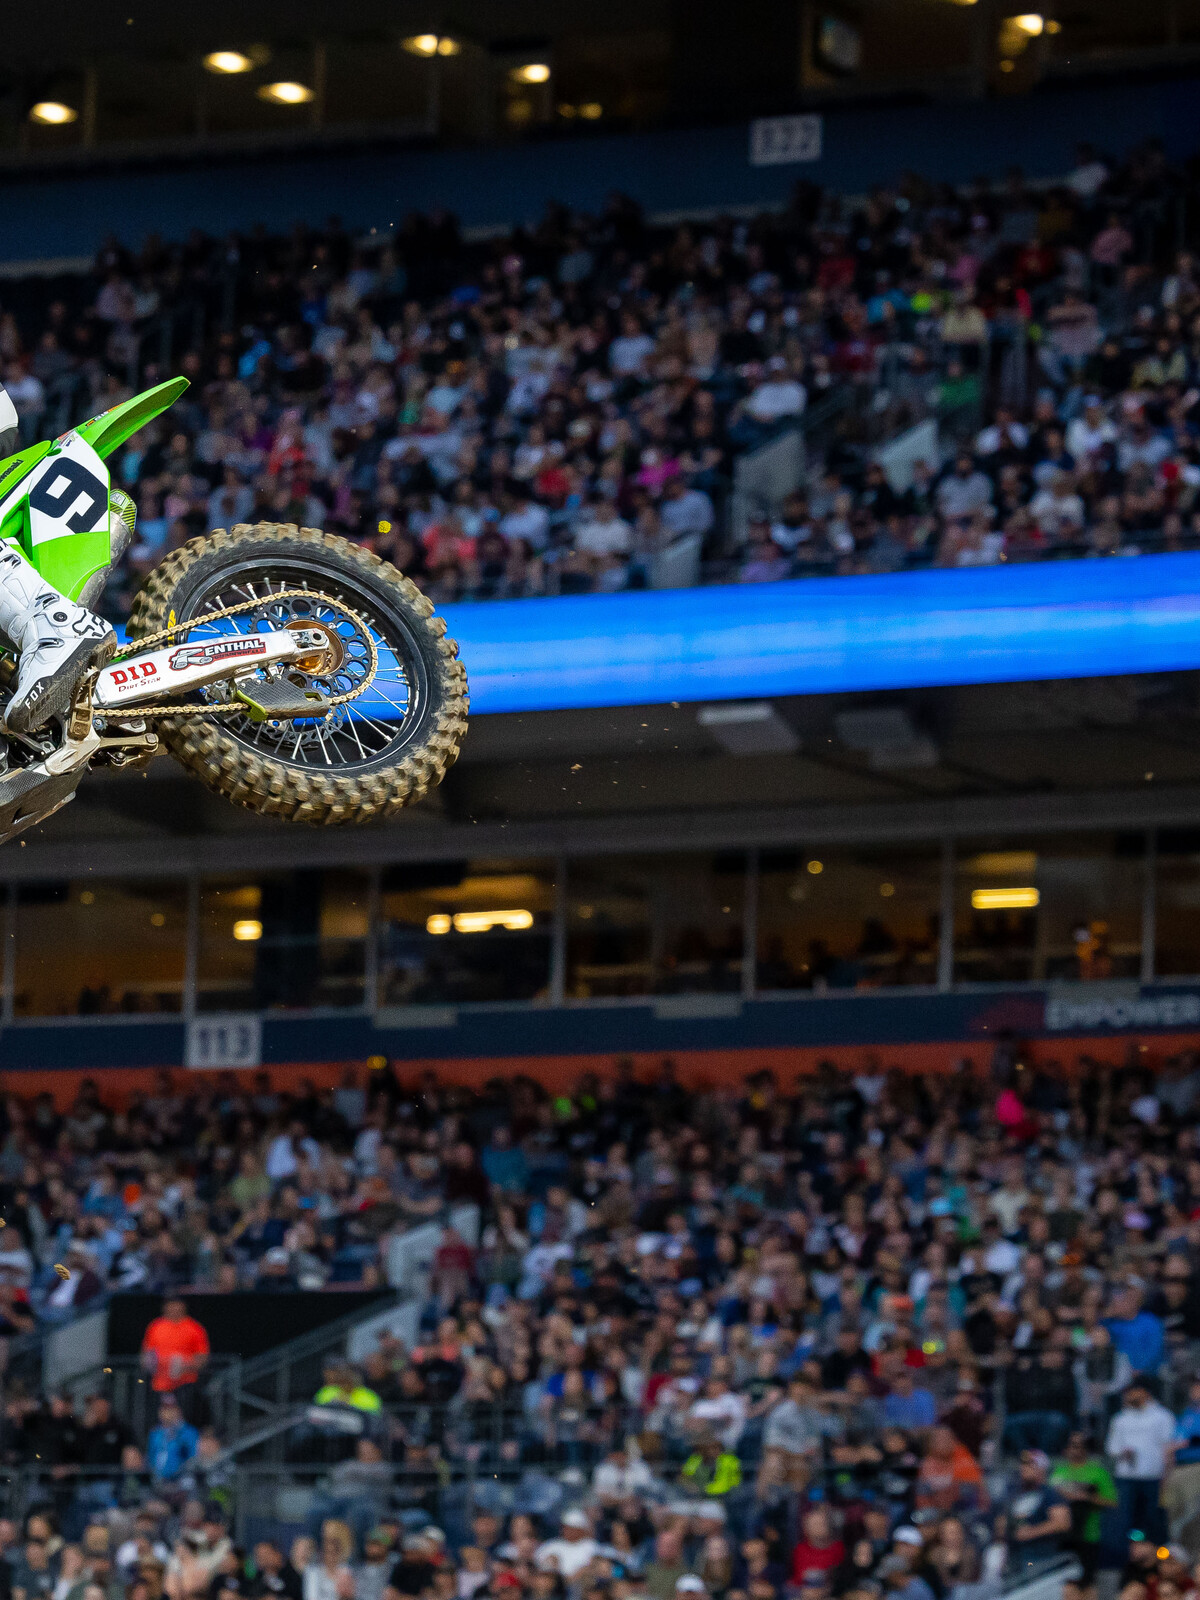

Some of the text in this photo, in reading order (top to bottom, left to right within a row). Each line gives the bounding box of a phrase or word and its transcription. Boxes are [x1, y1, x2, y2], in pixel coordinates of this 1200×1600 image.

[29, 456, 109, 534] 9
[110, 661, 157, 685] D.I.D
[24, 682, 45, 710] FOX
